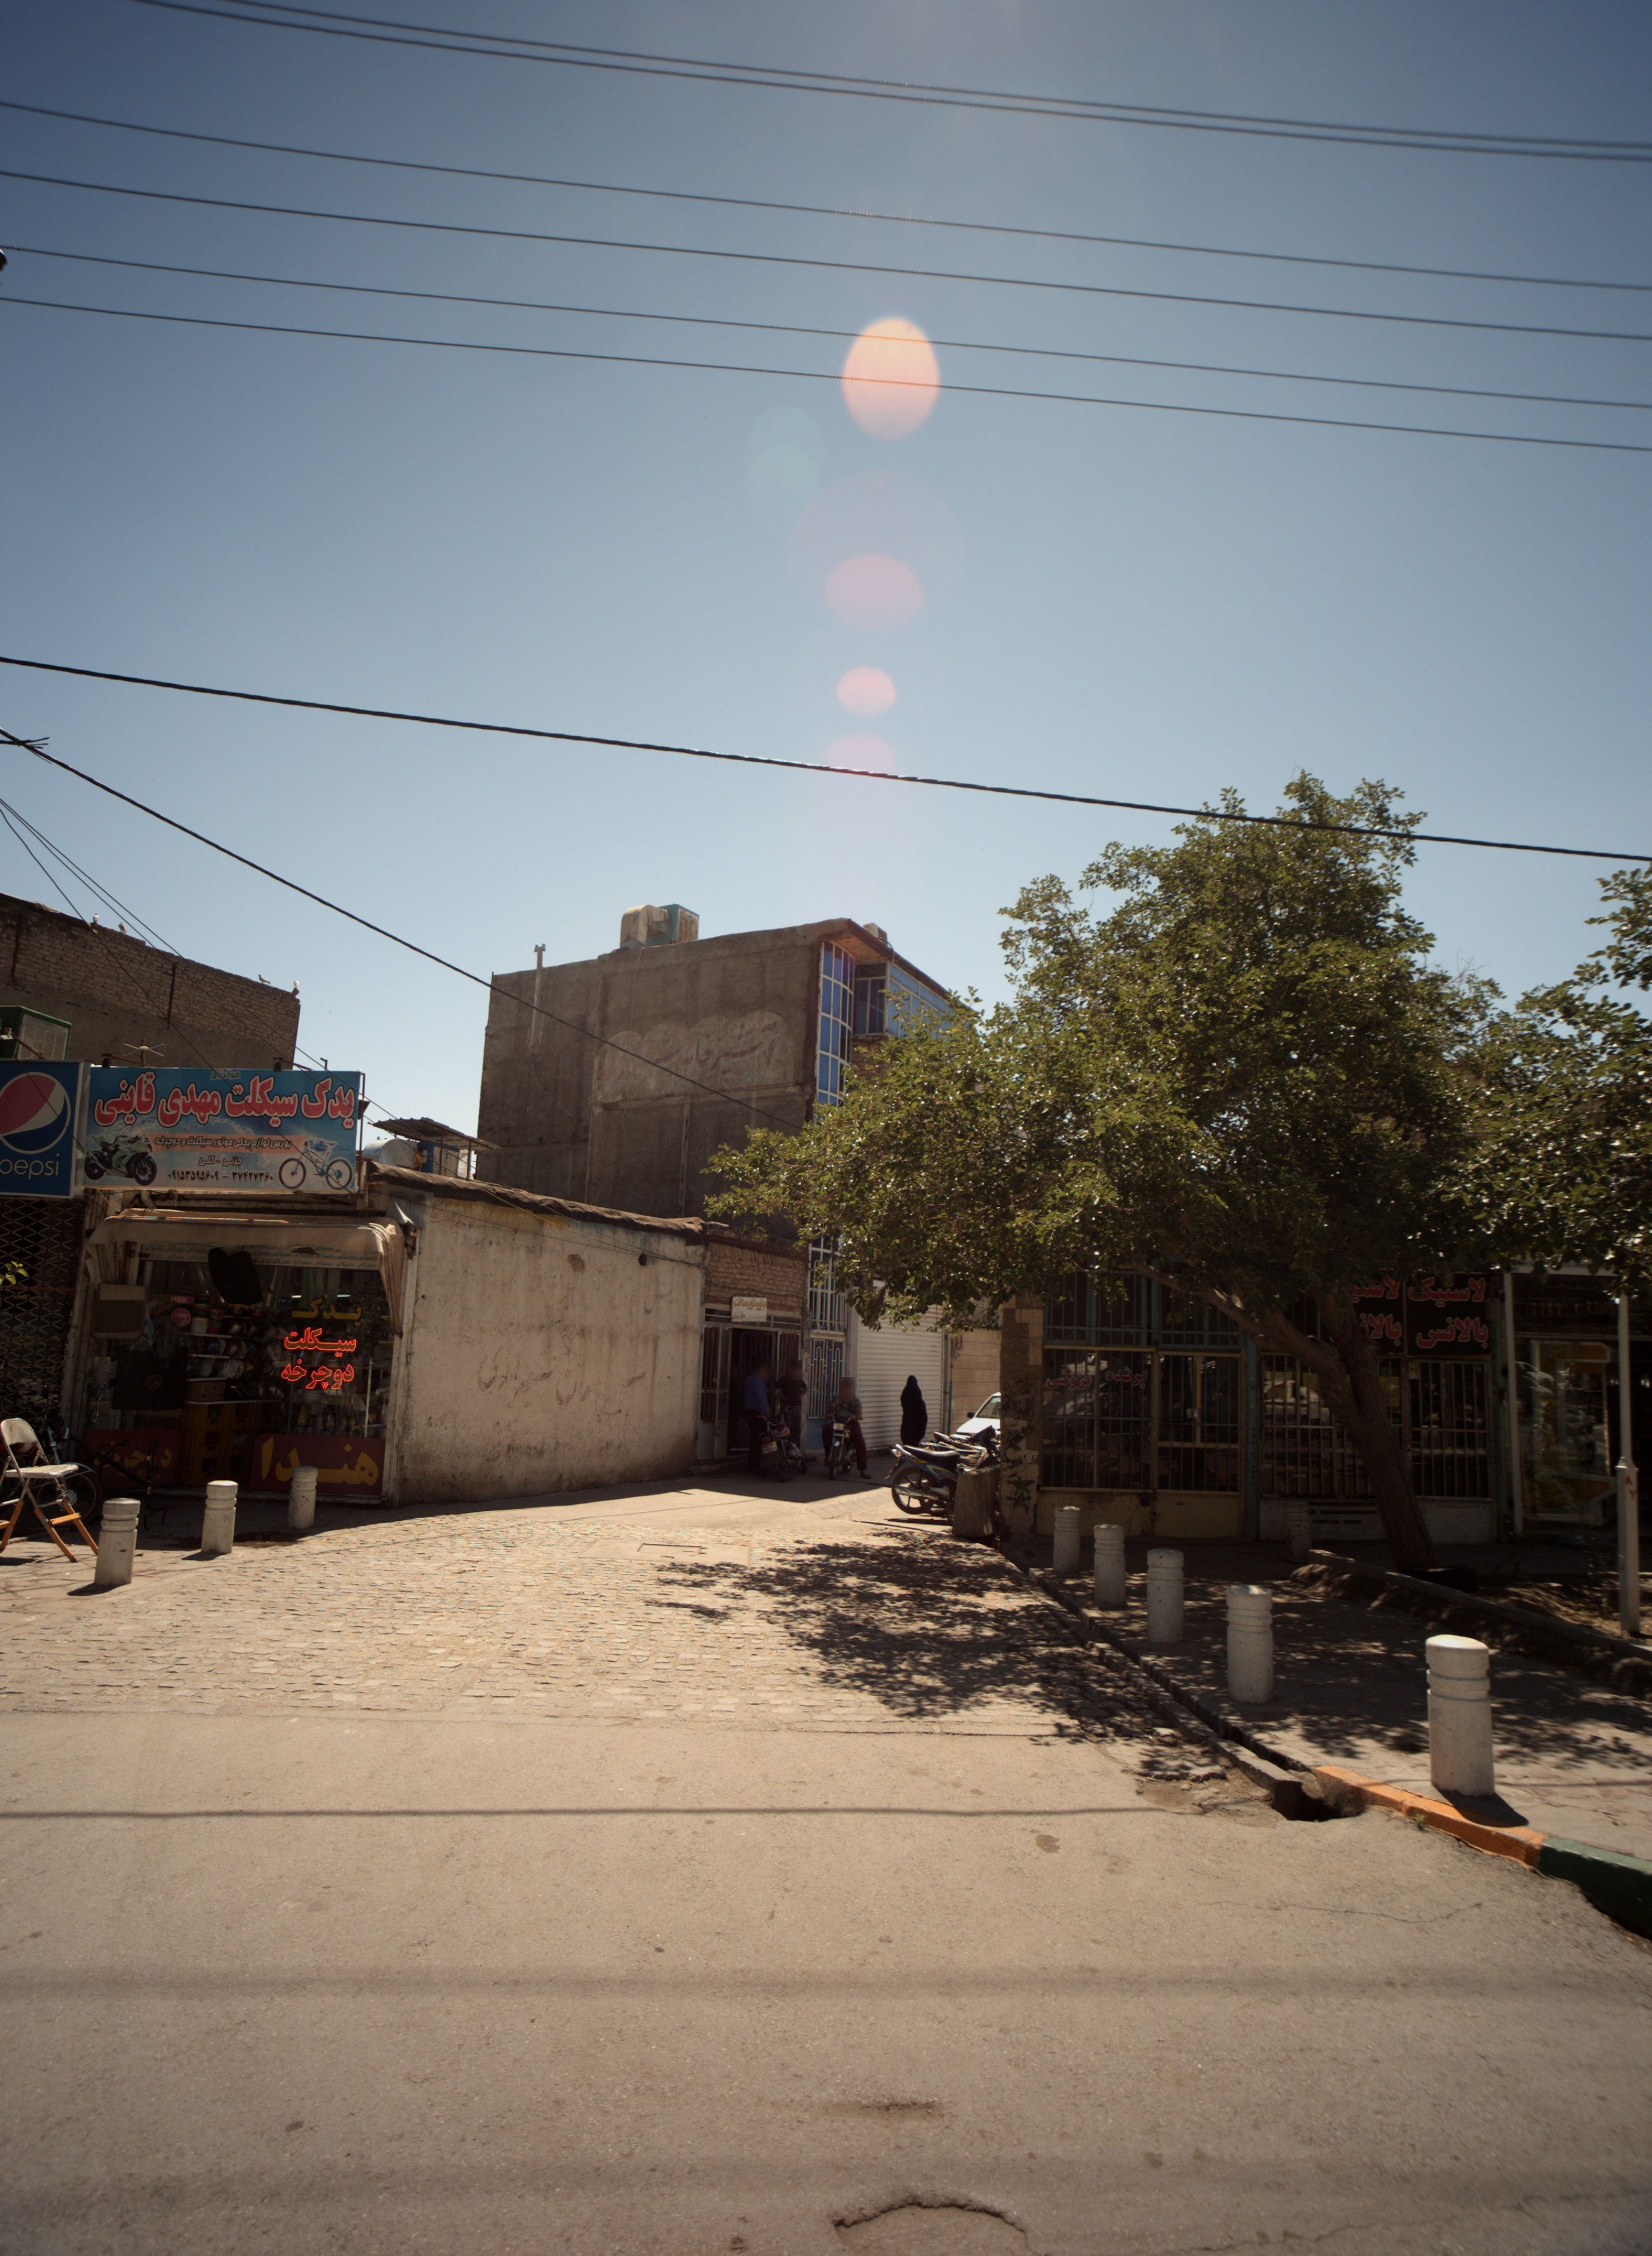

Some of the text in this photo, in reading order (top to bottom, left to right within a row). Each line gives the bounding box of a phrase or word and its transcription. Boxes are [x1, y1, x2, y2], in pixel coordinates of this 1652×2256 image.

[157, 1083, 222, 1127] مهدی
[225, 1075, 298, 1127] سیکلت
[302, 1077, 355, 1129] یدک
[155, 1136, 181, 1149] دوچرخه
[181, 1137, 186, 1146] و
[187, 1136, 213, 1148] سیکلت
[212, 1136, 233, 1147] موتور
[233, 1137, 251, 1149] یدکی
[250, 1137, 270, 1150] لوازم
[199, 1155, 215, 1166] کلی
[170, 1295, 188, 1304] NGK
[291, 1297, 362, 1325] یدک
[284, 1326, 357, 1358] سیکلت
[1360, 1313, 1401, 1346] بالان
[1416, 1317, 1489, 1349] بالانس
[281, 1358, 355, 1390] دوچرخه
[260, 1436, 379, 1486] هندا
